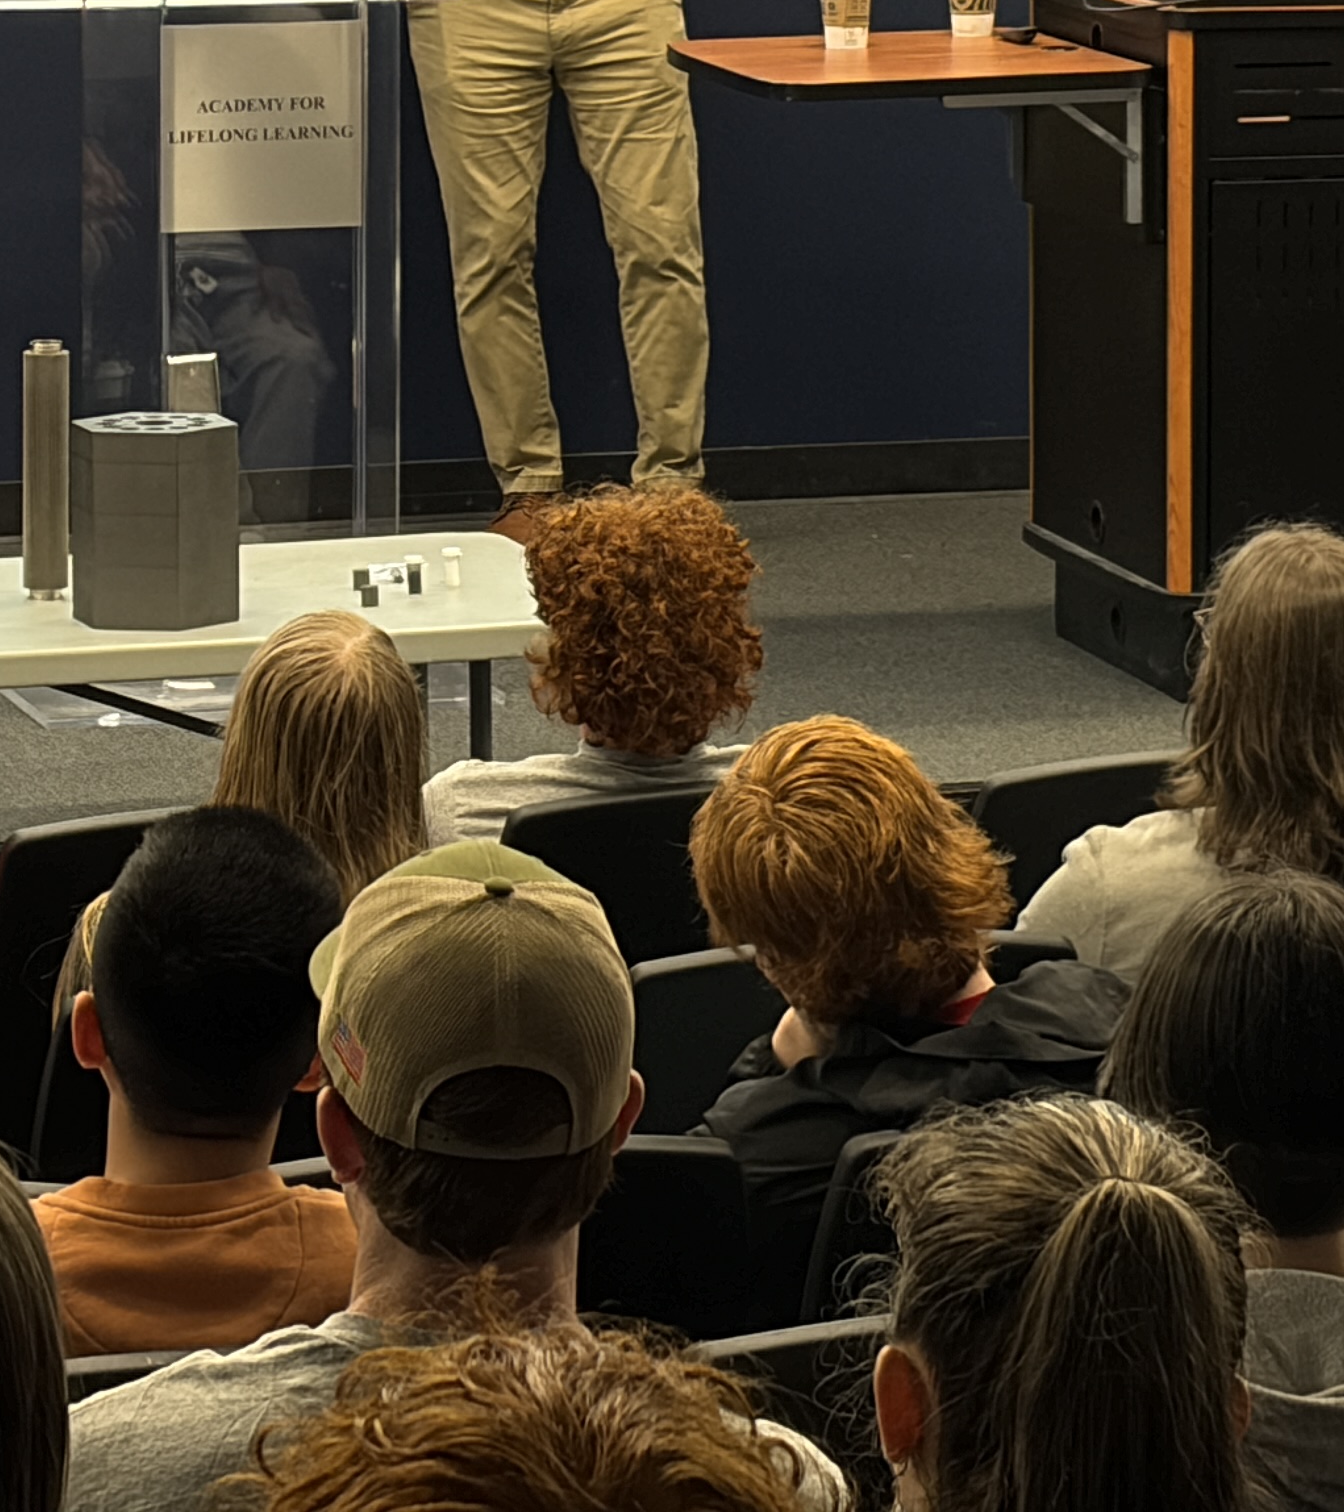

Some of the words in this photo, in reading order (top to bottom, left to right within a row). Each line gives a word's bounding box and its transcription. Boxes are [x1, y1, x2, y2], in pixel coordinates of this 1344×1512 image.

[197, 97, 285, 113] ACADEMY
[290, 96, 325, 112] FOR
[168, 129, 259, 145] LIFELONG
[263, 125, 354, 142] LEARNING
